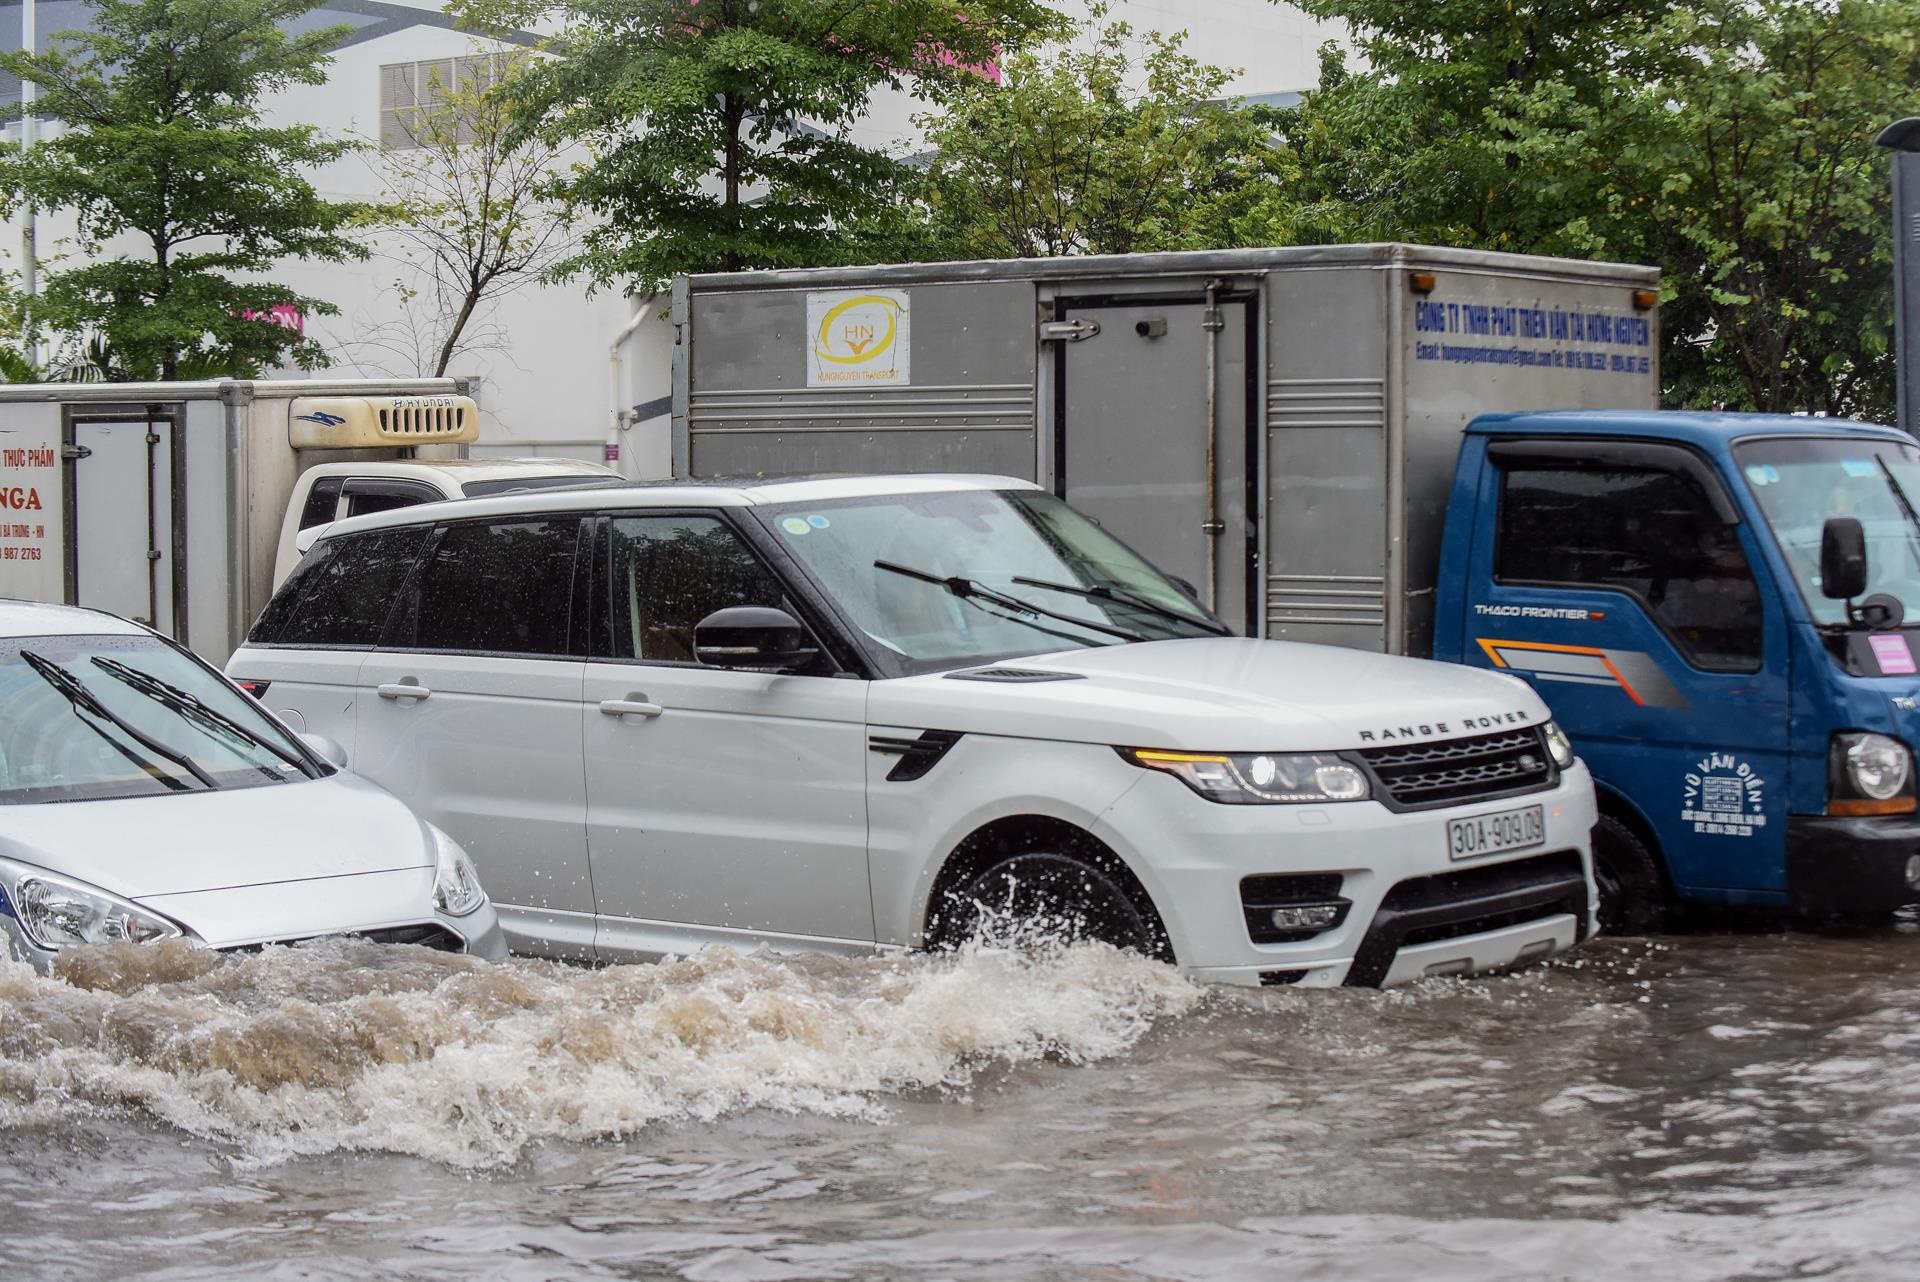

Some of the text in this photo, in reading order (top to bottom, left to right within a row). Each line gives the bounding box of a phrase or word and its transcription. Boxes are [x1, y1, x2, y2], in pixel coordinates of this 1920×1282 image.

[844, 325, 874, 339] HN
[406, 399, 454, 408] HYUNDAI
[3, 442, 55, 471] THỰC PHẨM
[4, 547, 19, 560] 987
[21, 547, 42, 560] 2763
[1474, 604, 1588, 620] THACO FRONTIER
[1359, 711, 1528, 742] RANGE ROVER
[1453, 810, 1542, 854] 30A-909.09
